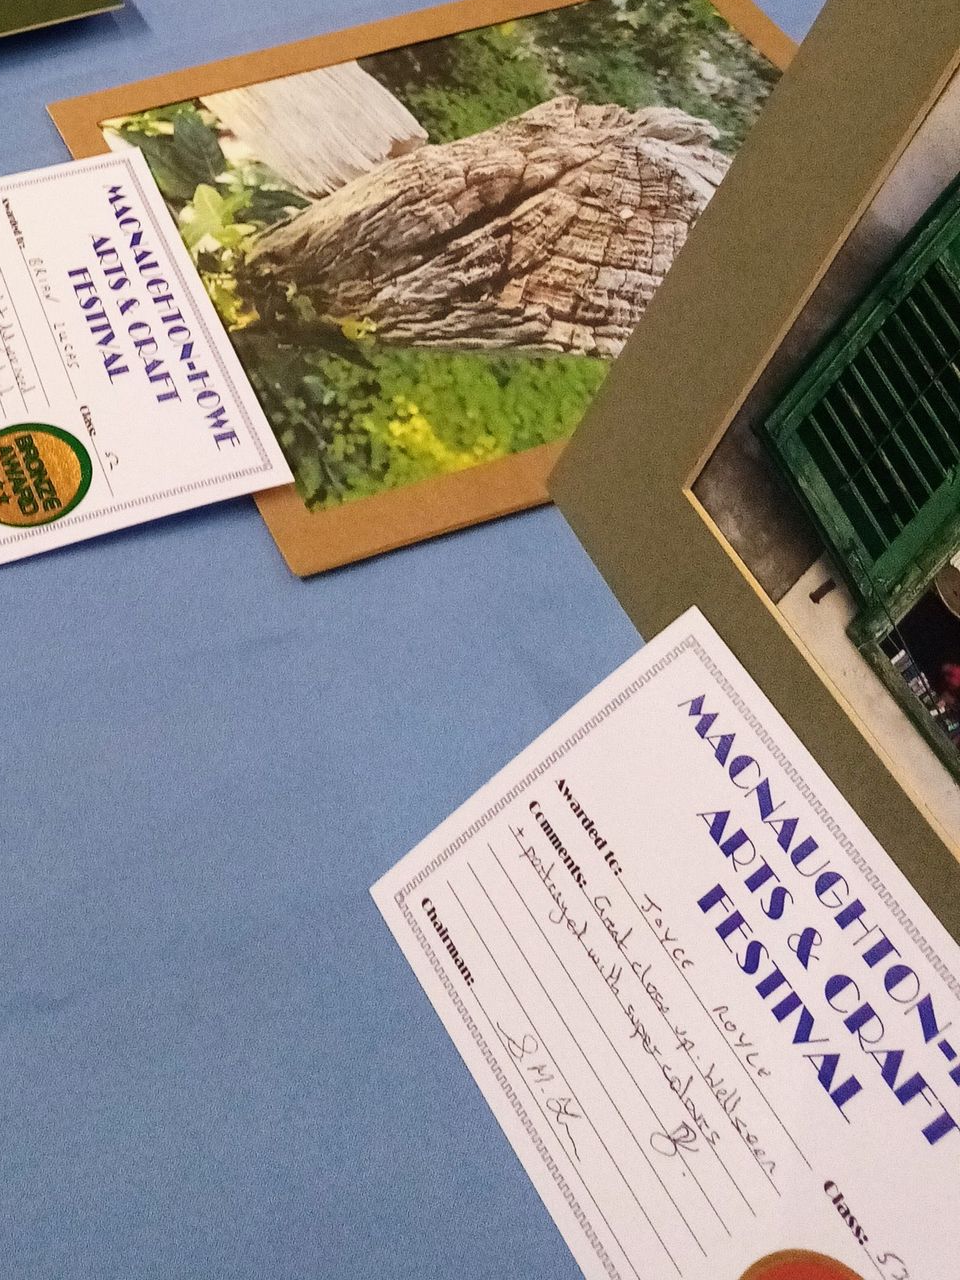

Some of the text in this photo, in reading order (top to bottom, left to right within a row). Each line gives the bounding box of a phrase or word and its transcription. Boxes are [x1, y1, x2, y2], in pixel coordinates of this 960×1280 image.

[67, 266, 130, 385] FESTIVAL
[89, 234, 182, 403] ARTS & CRAFT
[103, 185, 240, 451] MACNAUGHTON-HOWE
[14, 433, 63, 514] BRONZE
[528, 800, 588, 888] Comments:
[554, 779, 622, 880] Awarded to:
[421, 897, 475, 987] Chairman:
[520, 846, 588, 939] portrayed
[587, 948, 622, 1001] with
[624, 1004, 662, 1062] super
[589, 896, 633, 950] Great
[630, 961, 670, 1019] close
[696, 809, 960, 1146] ARTS & CRAFT
[695, 883, 865, 1125] FESTIVAL
[824, 1180, 868, 1246] Class:
